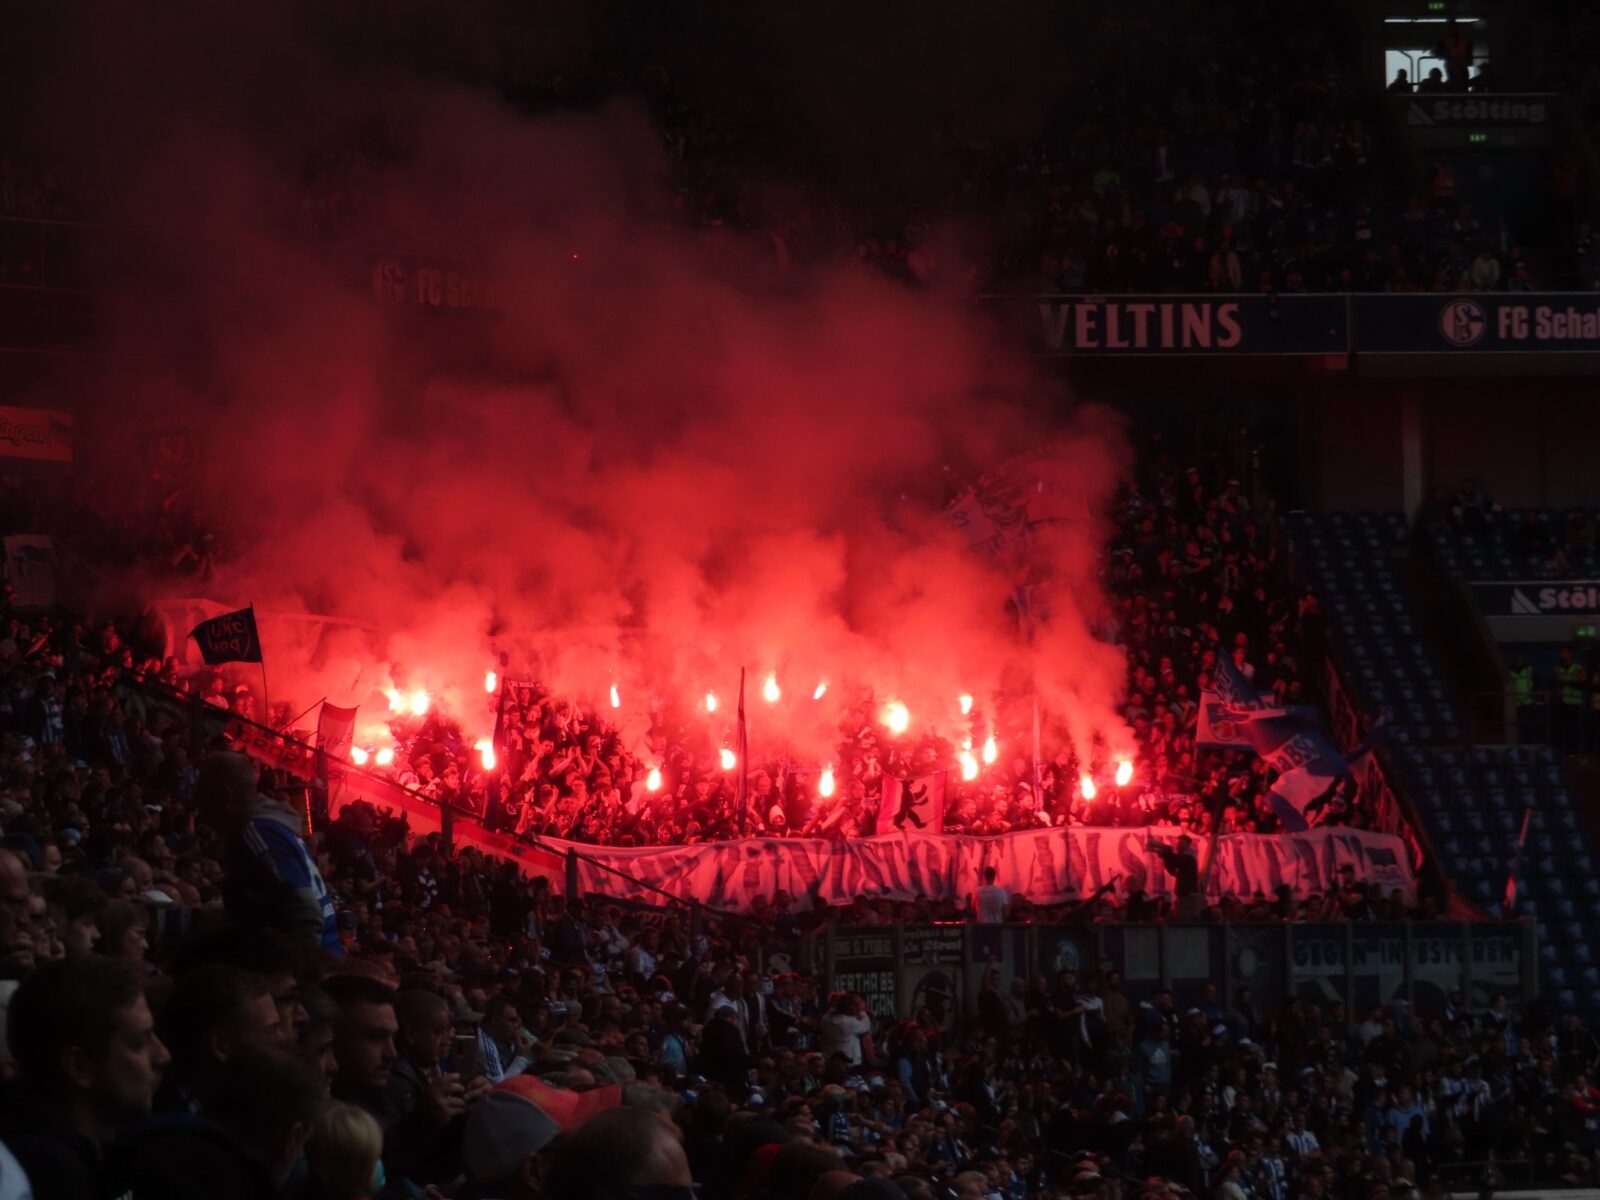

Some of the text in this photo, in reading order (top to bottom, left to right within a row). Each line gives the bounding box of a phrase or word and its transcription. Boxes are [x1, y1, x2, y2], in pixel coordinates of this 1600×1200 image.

[1432, 100, 1546, 123] Stölting
[1038, 302, 1243, 348] VELTINS
[1496, 305, 1600, 340] FC Scha
[1538, 586, 1600, 609] Stöl
[1294, 936, 1514, 967] GEGN INESTOREN
